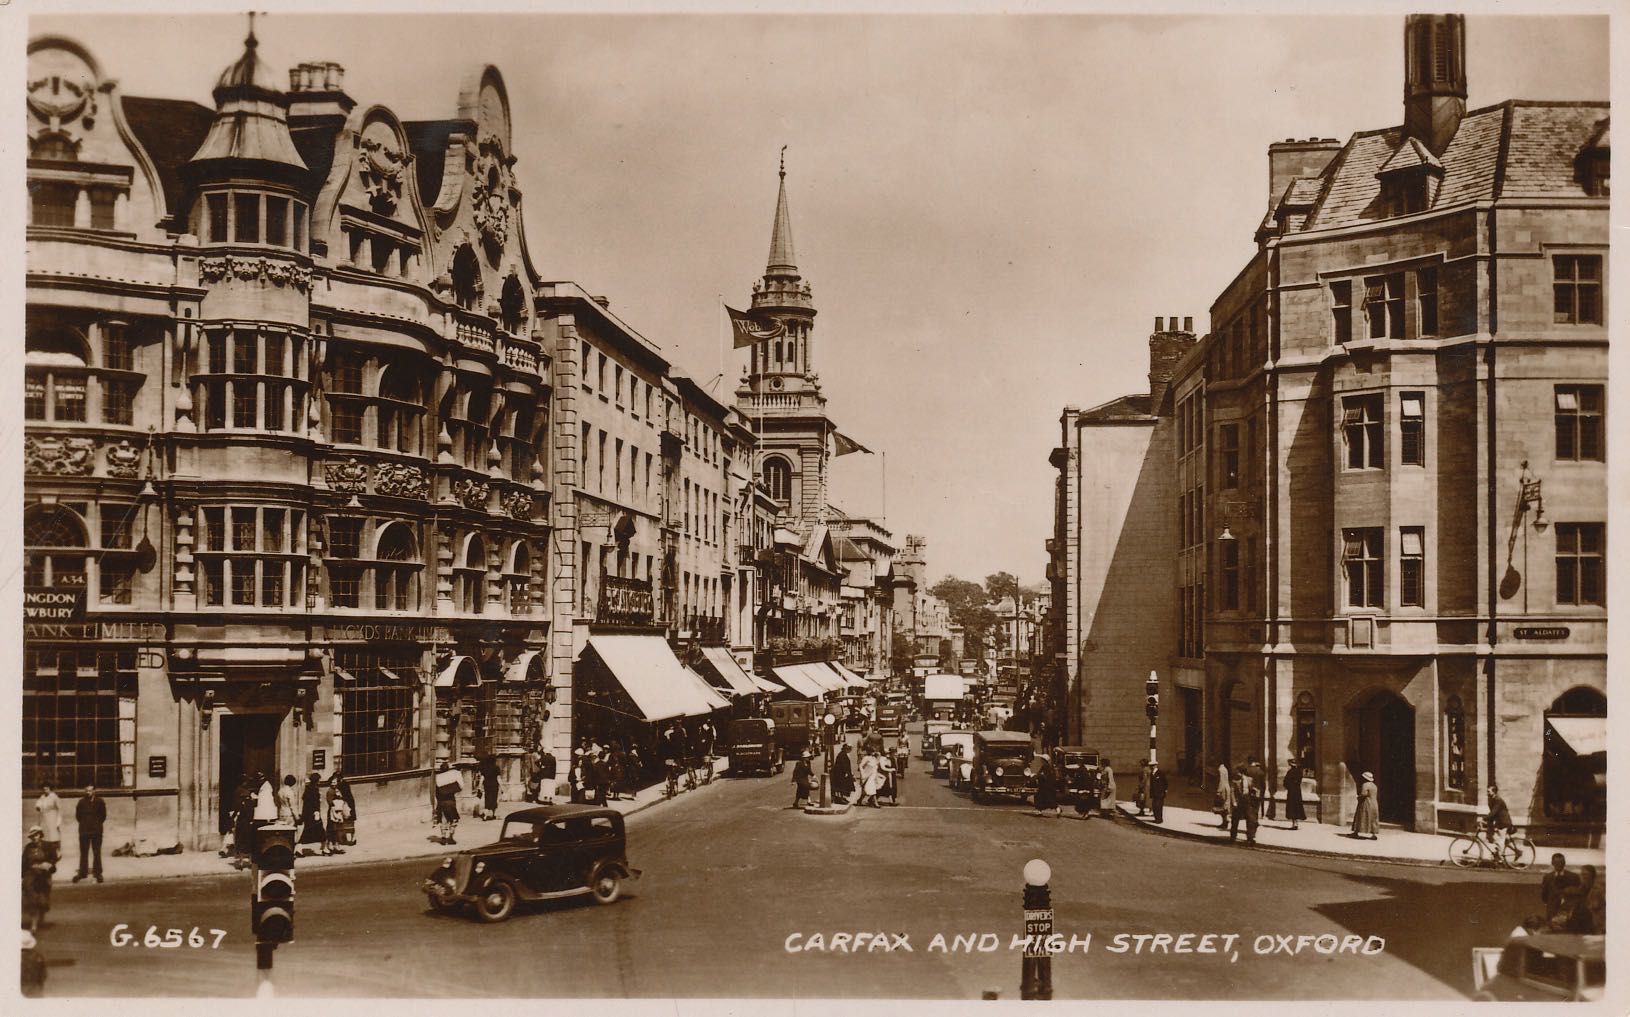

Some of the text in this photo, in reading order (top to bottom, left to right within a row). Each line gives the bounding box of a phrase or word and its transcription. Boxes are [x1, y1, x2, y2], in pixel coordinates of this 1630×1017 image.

[24, 593, 76, 604] NGDON
[83, 622, 167, 639] LIMITED
[1027, 923, 1051, 932] STOP
